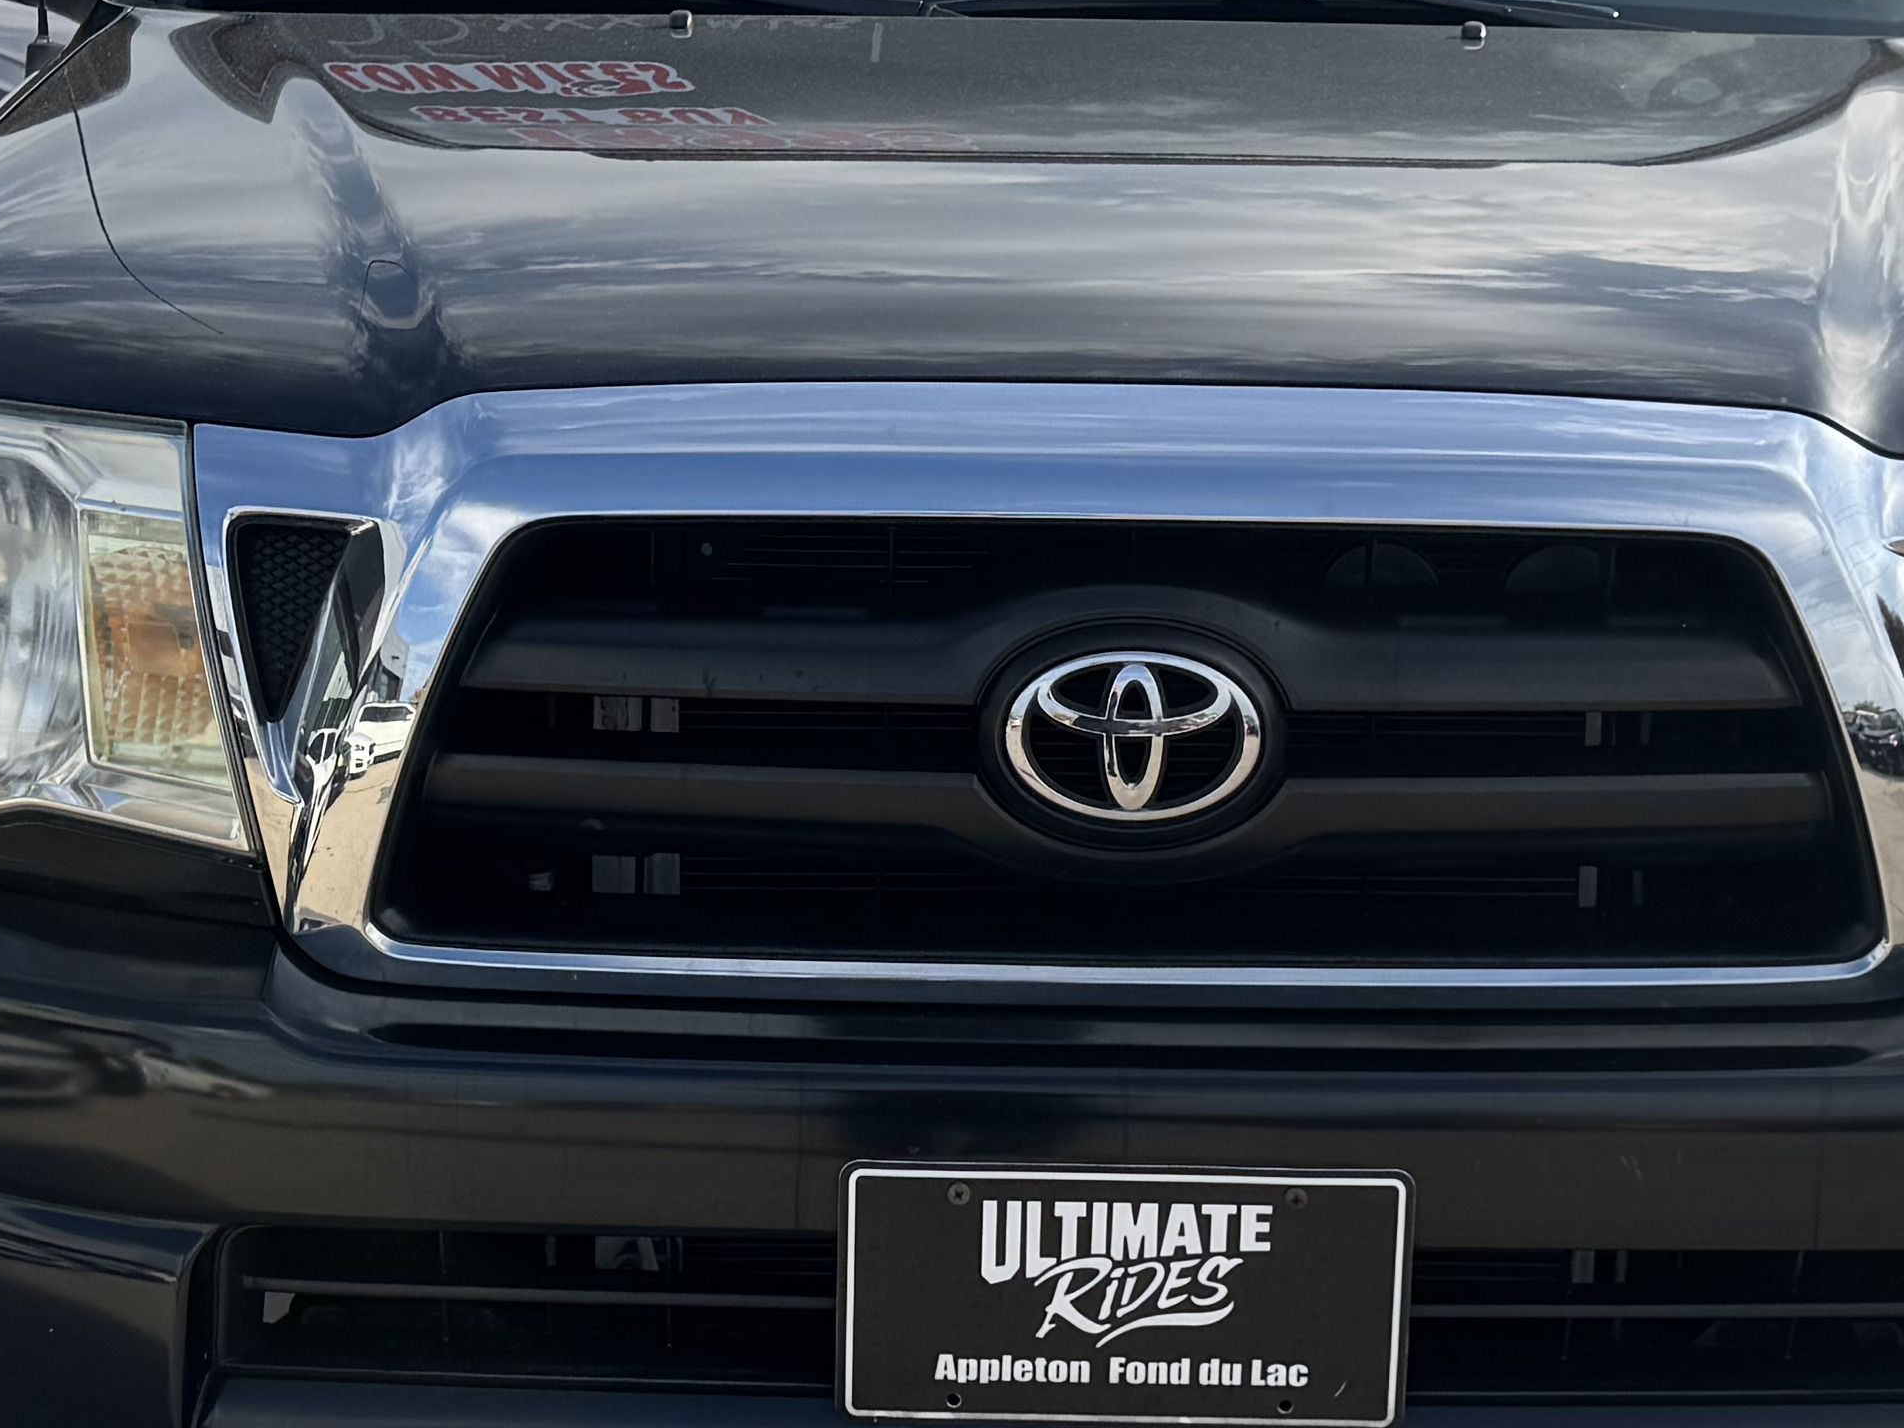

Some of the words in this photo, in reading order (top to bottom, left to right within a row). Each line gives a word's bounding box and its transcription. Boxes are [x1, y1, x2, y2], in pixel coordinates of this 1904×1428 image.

[980, 1199, 1274, 1285] ULTIMATE
[934, 1353, 1092, 1384] Appleton
[1108, 1356, 1191, 1385] Fond
[1198, 1358, 1243, 1387] du
[1250, 1359, 1310, 1388] Lac
